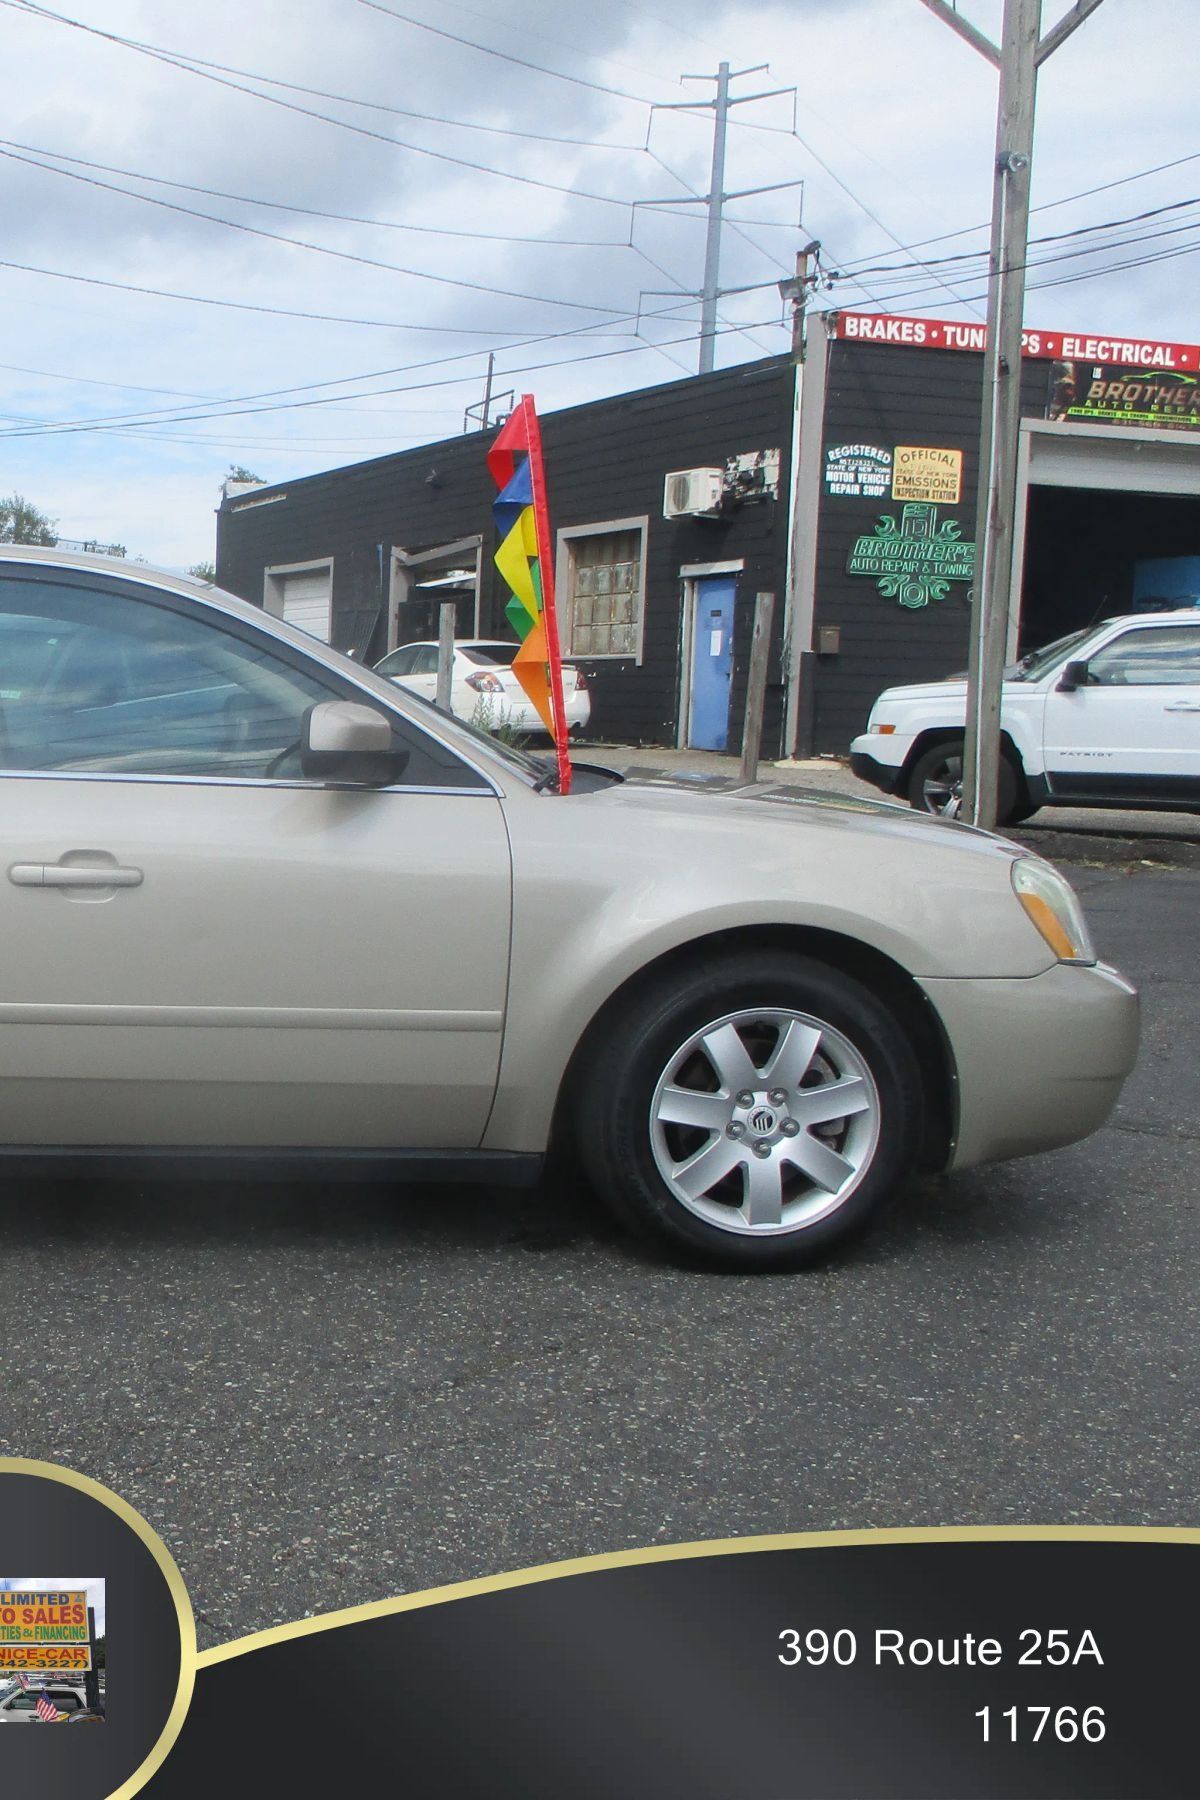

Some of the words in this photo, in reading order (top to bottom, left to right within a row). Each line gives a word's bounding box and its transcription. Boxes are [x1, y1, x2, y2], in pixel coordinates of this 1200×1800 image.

[845, 317, 926, 344] BRAKES
[943, 325, 988, 348] TUN
[1062, 338, 1176, 368] ELECTRICAL
[1085, 399, 1133, 410] AUTO
[827, 444, 891, 465] REGISTERED
[900, 449, 955, 468] OFFICIAL
[825, 470, 855, 483] MOTOR
[857, 472, 891, 485] VEHICLE
[895, 475, 957, 489] EMISSIONS
[830, 483, 860, 495] REPAIR
[863, 485, 886, 497] SHOP
[894, 487, 930, 499] INSPECTION
[931, 489, 957, 500] STATION
[850, 558, 879, 571] AUTO
[881, 559, 919, 573] REPAIR
[922, 561, 931, 574] &
[933, 562, 973, 576] TOWING
